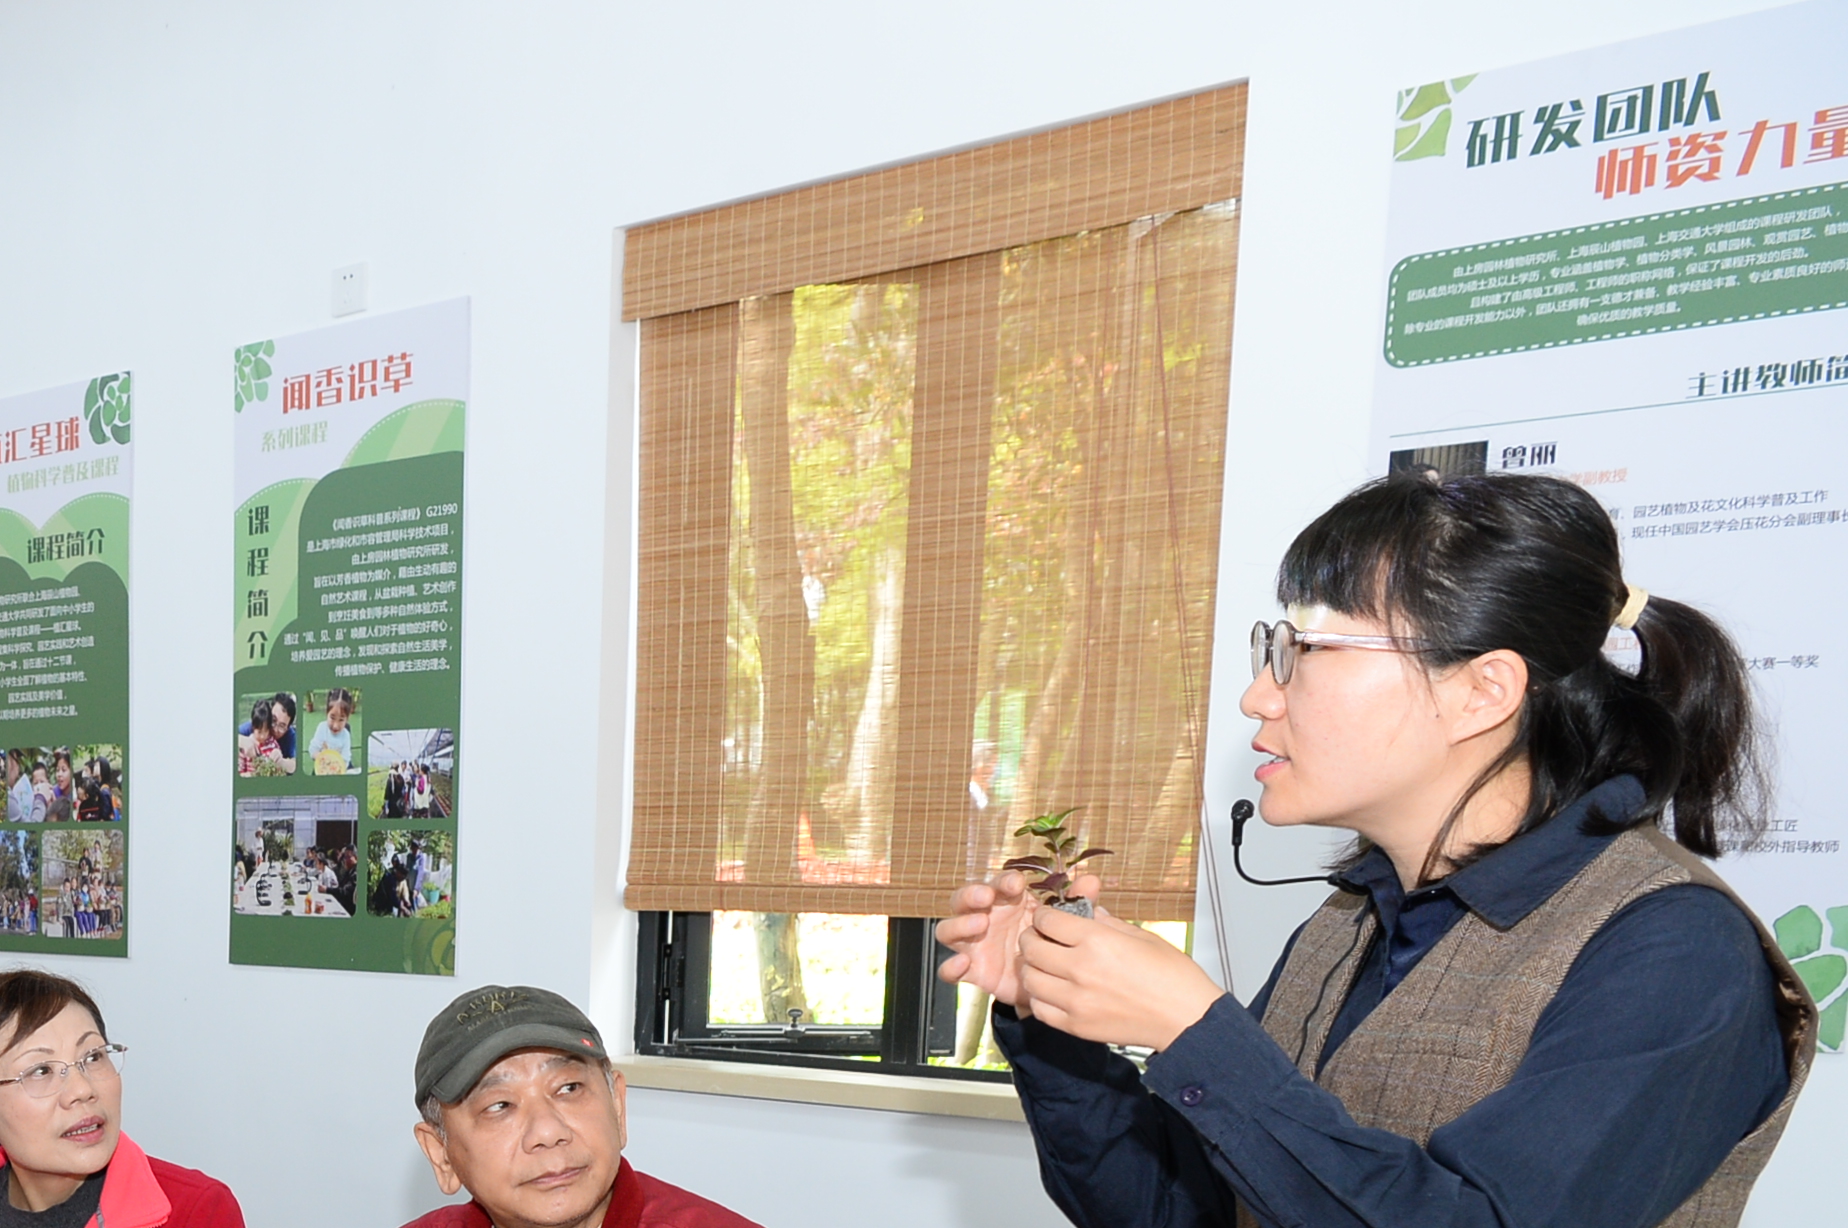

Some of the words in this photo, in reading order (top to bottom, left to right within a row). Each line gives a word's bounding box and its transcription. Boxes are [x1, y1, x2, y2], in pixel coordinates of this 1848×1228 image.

[1465, 71, 1722, 169] 研发团队
[1594, 104, 1848, 201] 师资力量
[281, 352, 415, 415] 闻香识草
[1686, 354, 1848, 399] 主讲教师简
[261, 420, 329, 453] 系列课程
[7, 455, 120, 494] 植物科学普及课程
[1558, 467, 1627, 486] 学副教授
[426, 502, 458, 518] G21990
[27, 527, 105, 564] 课程简介
[246, 505, 270, 660] 课程简介
